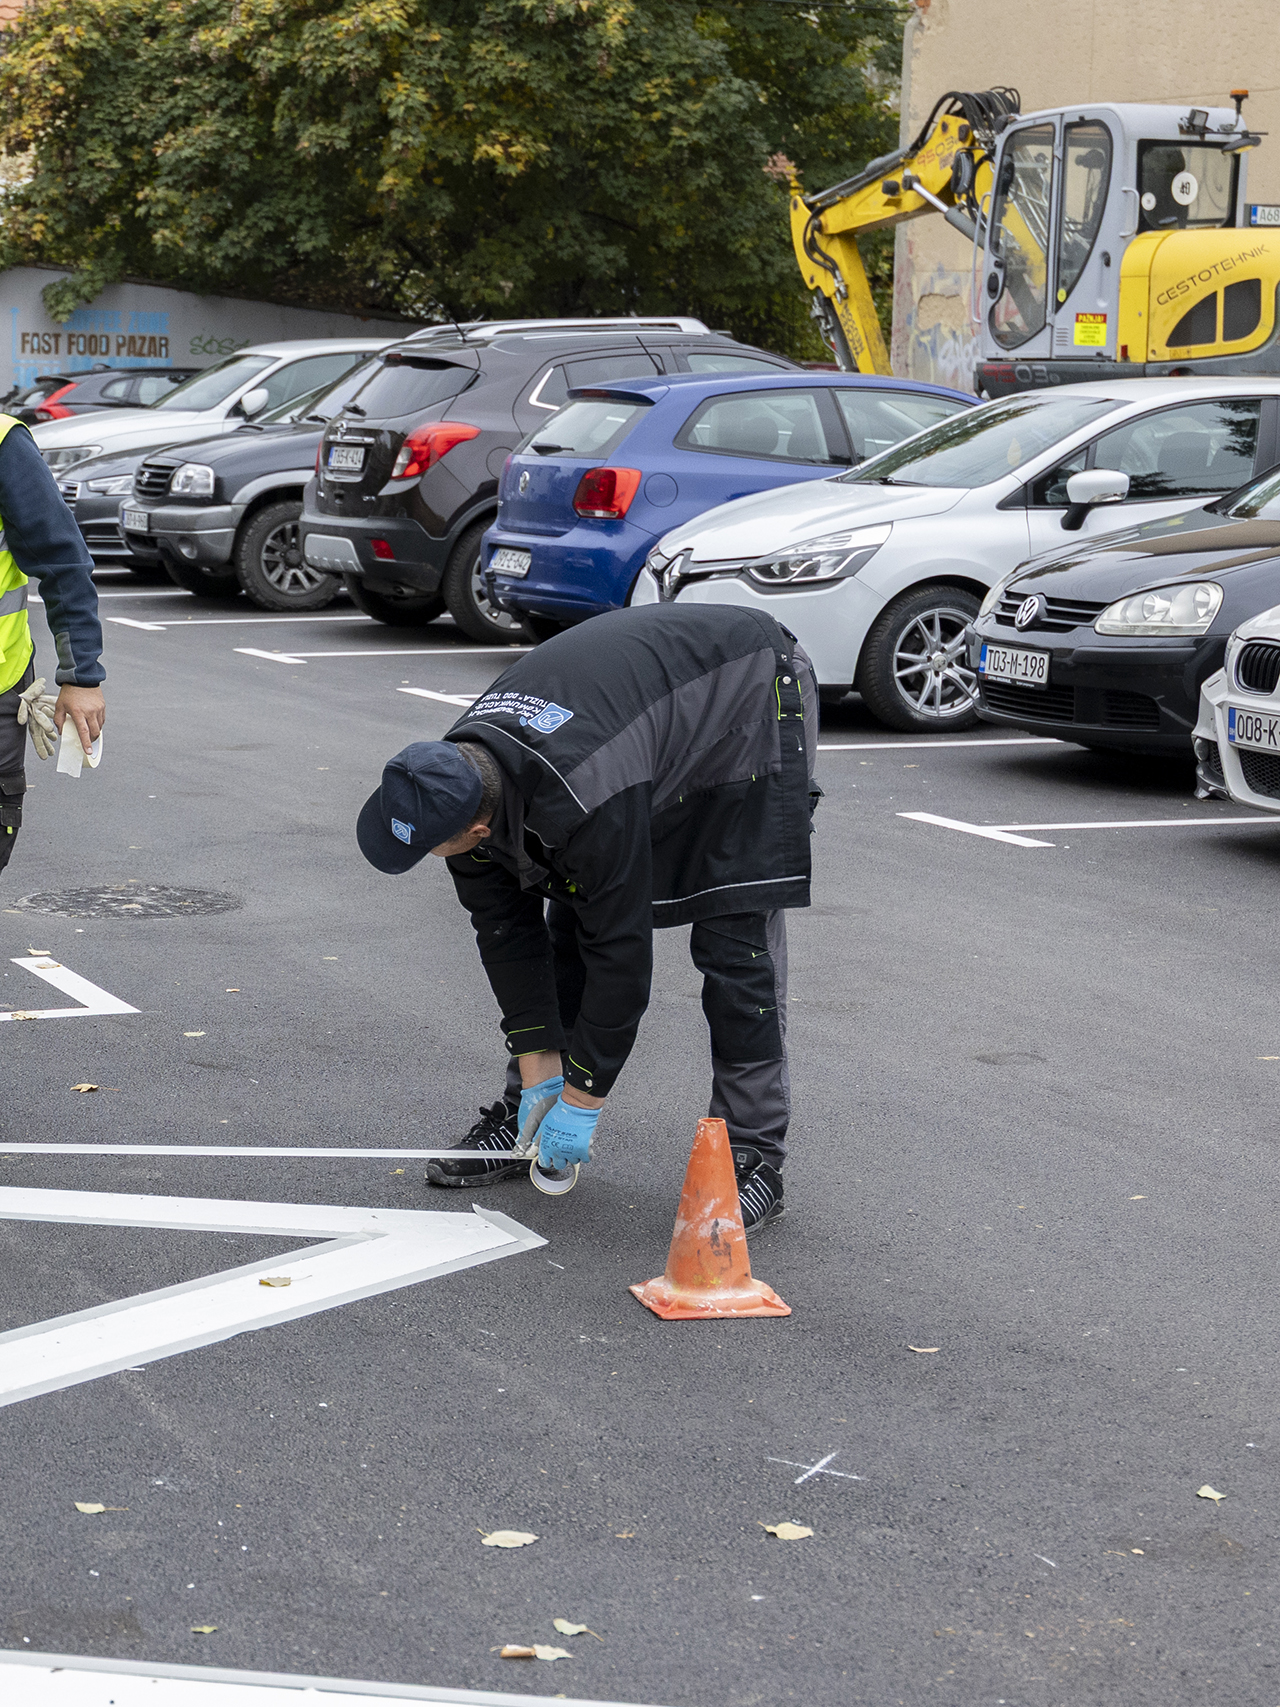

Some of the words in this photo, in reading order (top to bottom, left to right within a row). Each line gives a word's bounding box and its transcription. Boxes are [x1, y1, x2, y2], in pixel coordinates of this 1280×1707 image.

[1157, 244, 1270, 306] CESTOTEHNIK
[21, 332, 61, 355] FAST
[67, 334, 109, 356] FOOD
[116, 335, 169, 358] PAZAR
[987, 649, 1046, 678] T03-M-198
